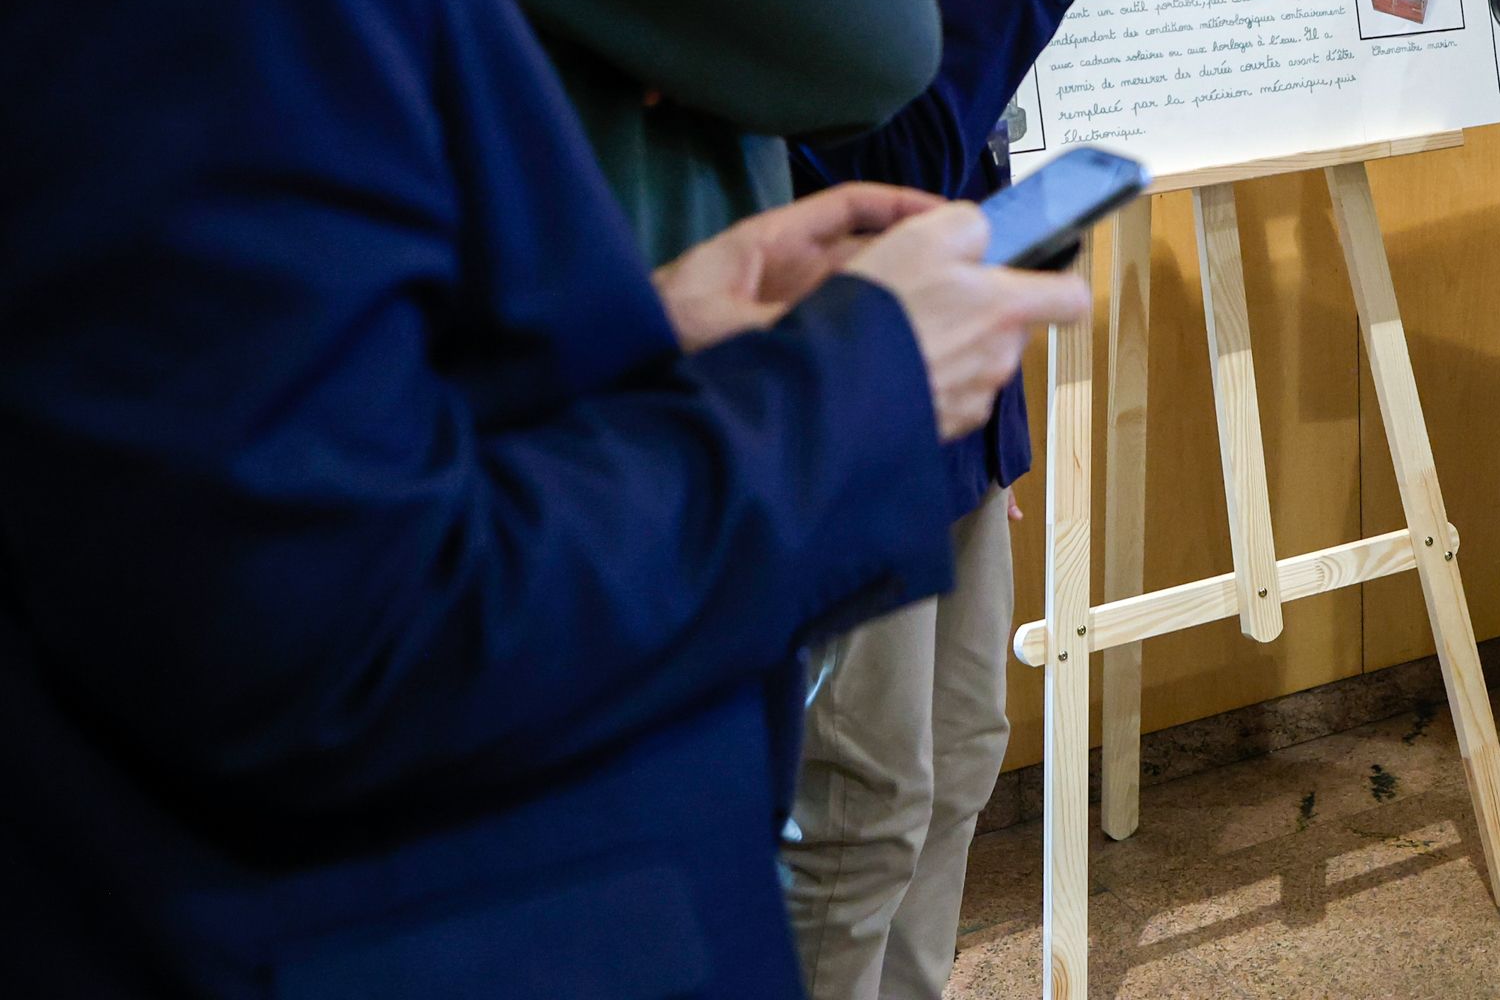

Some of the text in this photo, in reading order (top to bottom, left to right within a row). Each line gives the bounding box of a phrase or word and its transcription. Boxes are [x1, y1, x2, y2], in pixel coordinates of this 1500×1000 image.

[1097, 9, 1115, 17] un
[1119, 0, 1149, 15] outil
[1123, 27, 1139, 39] des
[1145, 22, 1194, 36] conditions
[1050, 61, 1074, 71] aux
[1079, 53, 1121, 67] cadrans
[1125, 50, 1164, 62] solaires
[1187, 46, 1208, 56] aux
[1212, 38, 1254, 53] horloges
[1257, 35, 1266, 46] à
[1303, 26, 1319, 41] Il
[1324, 32, 1333, 40] a
[1056, 49, 1355, 100] permis de mesurer des durées courtes avant d'être
[1058, 99, 1123, 121] remplacé
[1131, 100, 1159, 117] par
[1164, 94, 1185, 107] la
[1191, 88, 1253, 108] précision
[1335, 73, 1357, 90] puis
